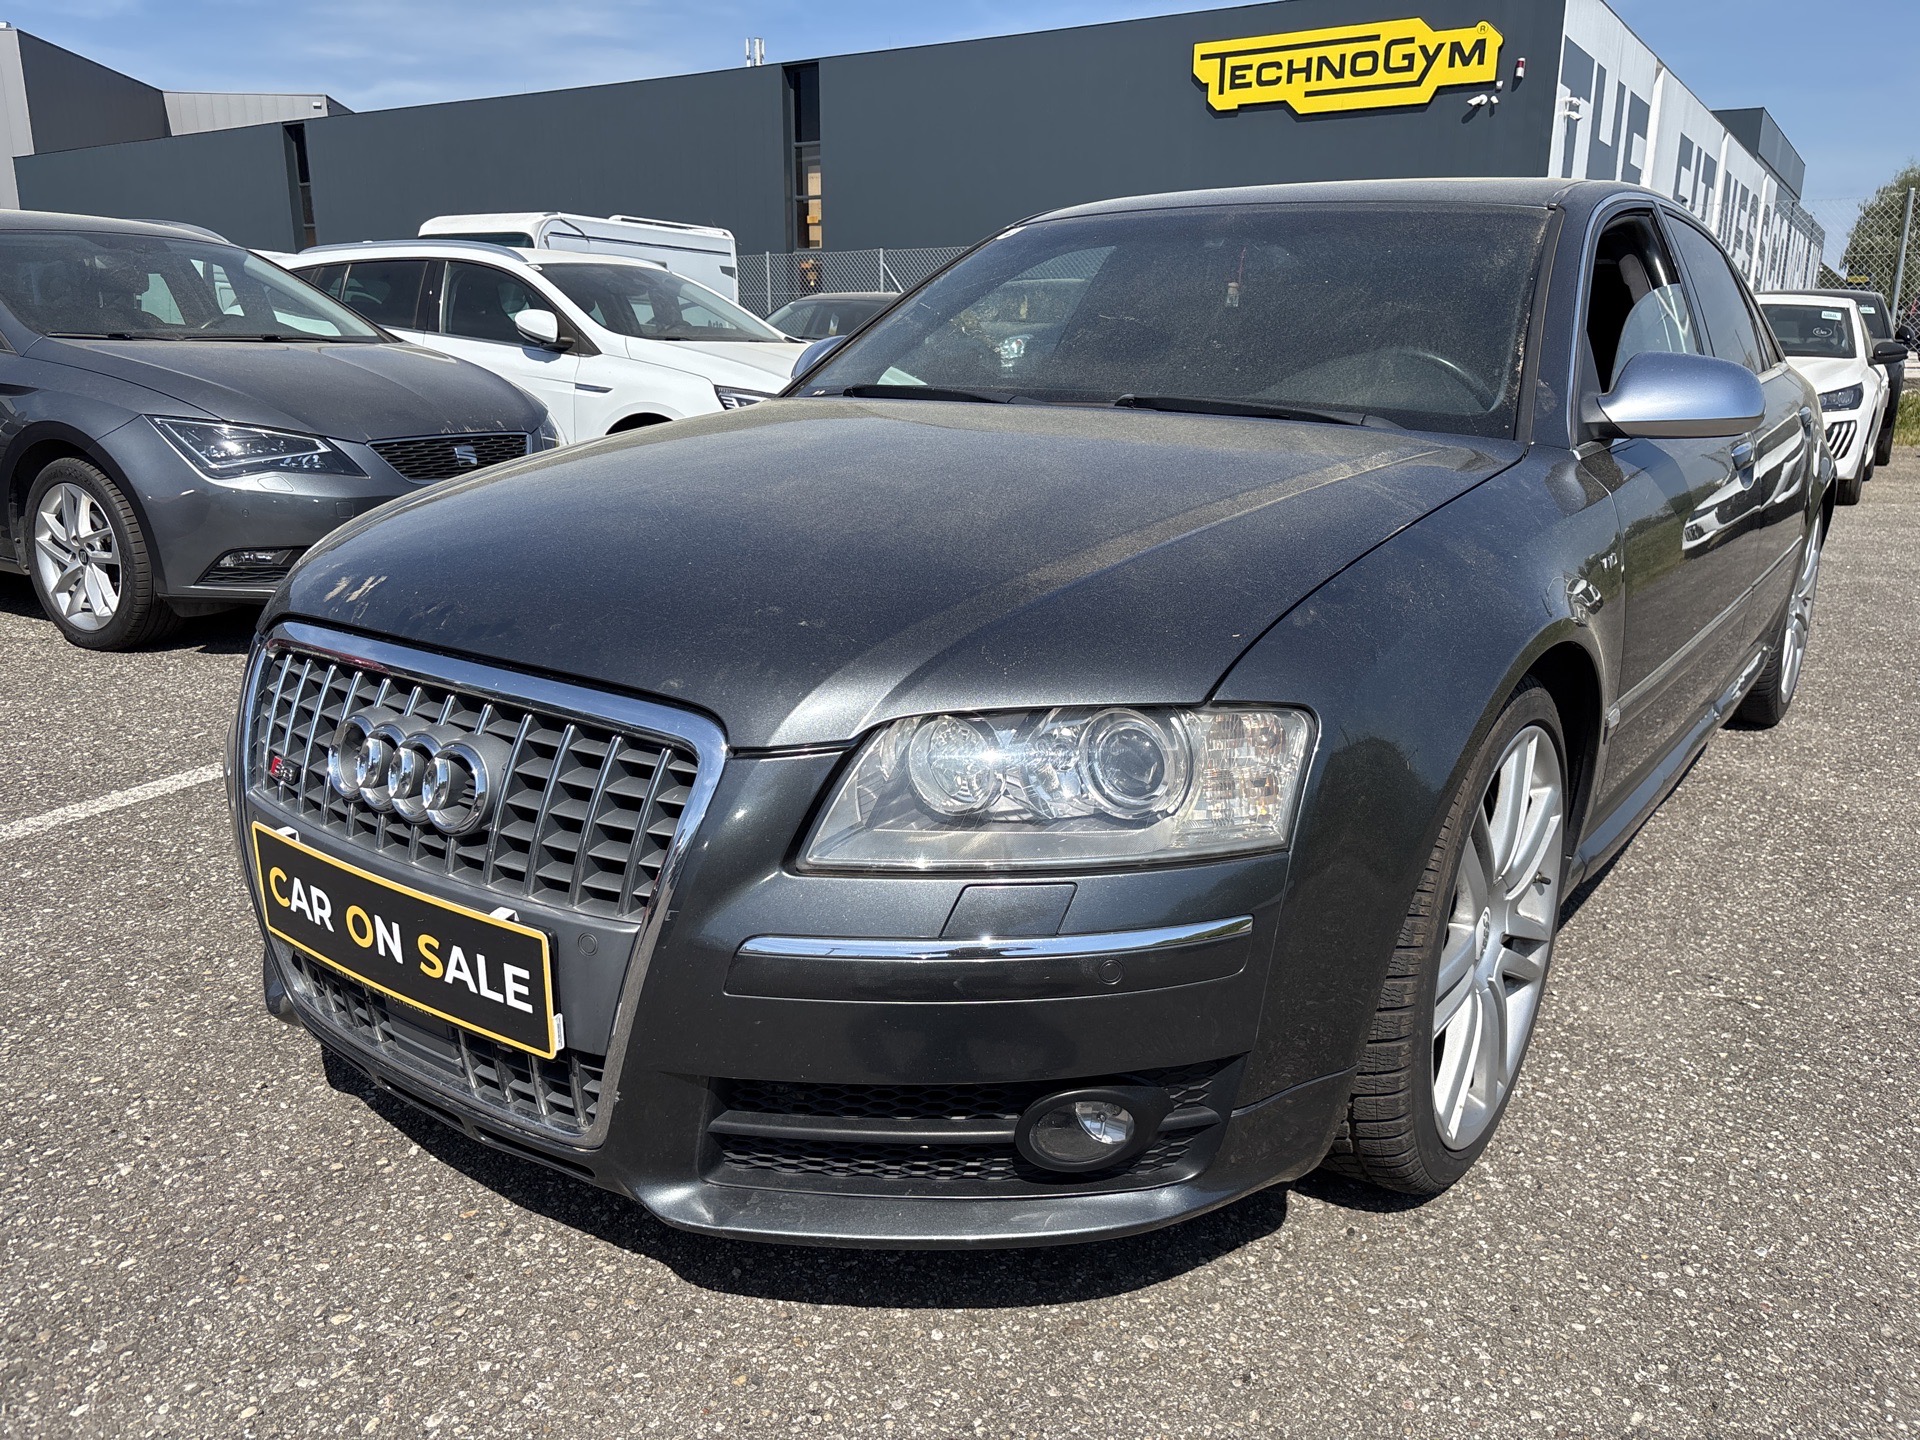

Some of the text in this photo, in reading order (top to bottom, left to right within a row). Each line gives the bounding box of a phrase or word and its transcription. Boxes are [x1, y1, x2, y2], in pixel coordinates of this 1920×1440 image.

[1200, 36, 1487, 96] TECHNOGYM
[269, 866, 334, 932] CAR
[345, 905, 403, 964] ON
[417, 934, 533, 1013] SALE
